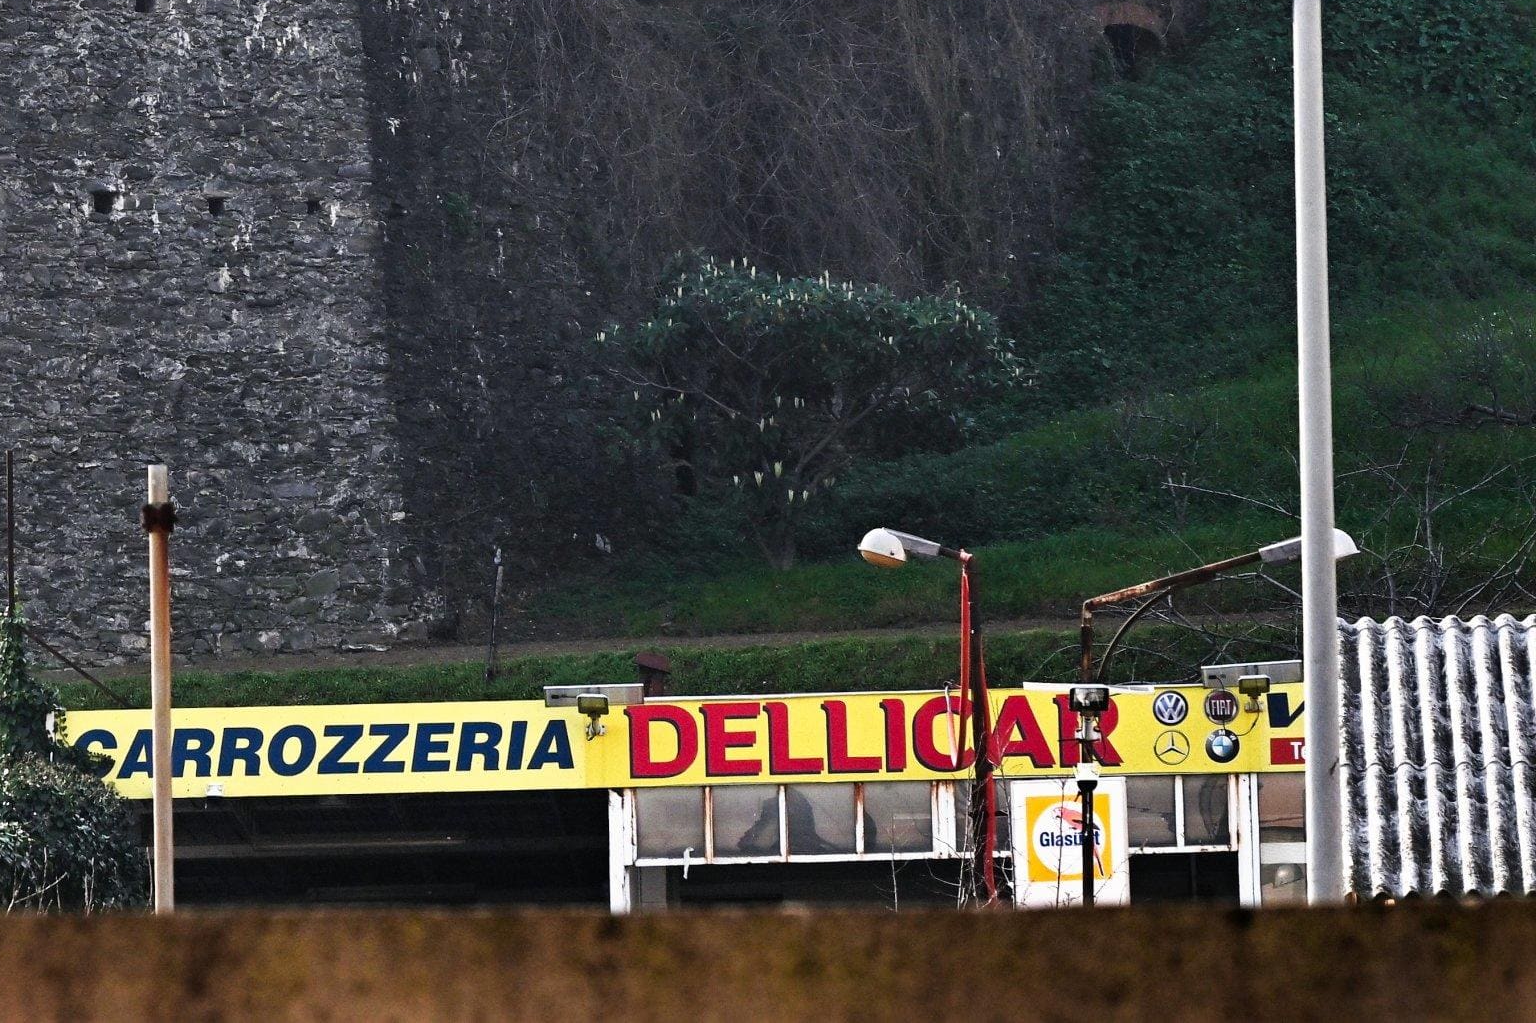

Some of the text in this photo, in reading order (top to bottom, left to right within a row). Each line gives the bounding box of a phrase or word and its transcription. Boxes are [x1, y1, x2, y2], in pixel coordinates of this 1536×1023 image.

[1210, 699, 1232, 716] FIAT
[72, 694, 1124, 779] CARROZZERIA DELLICAR
